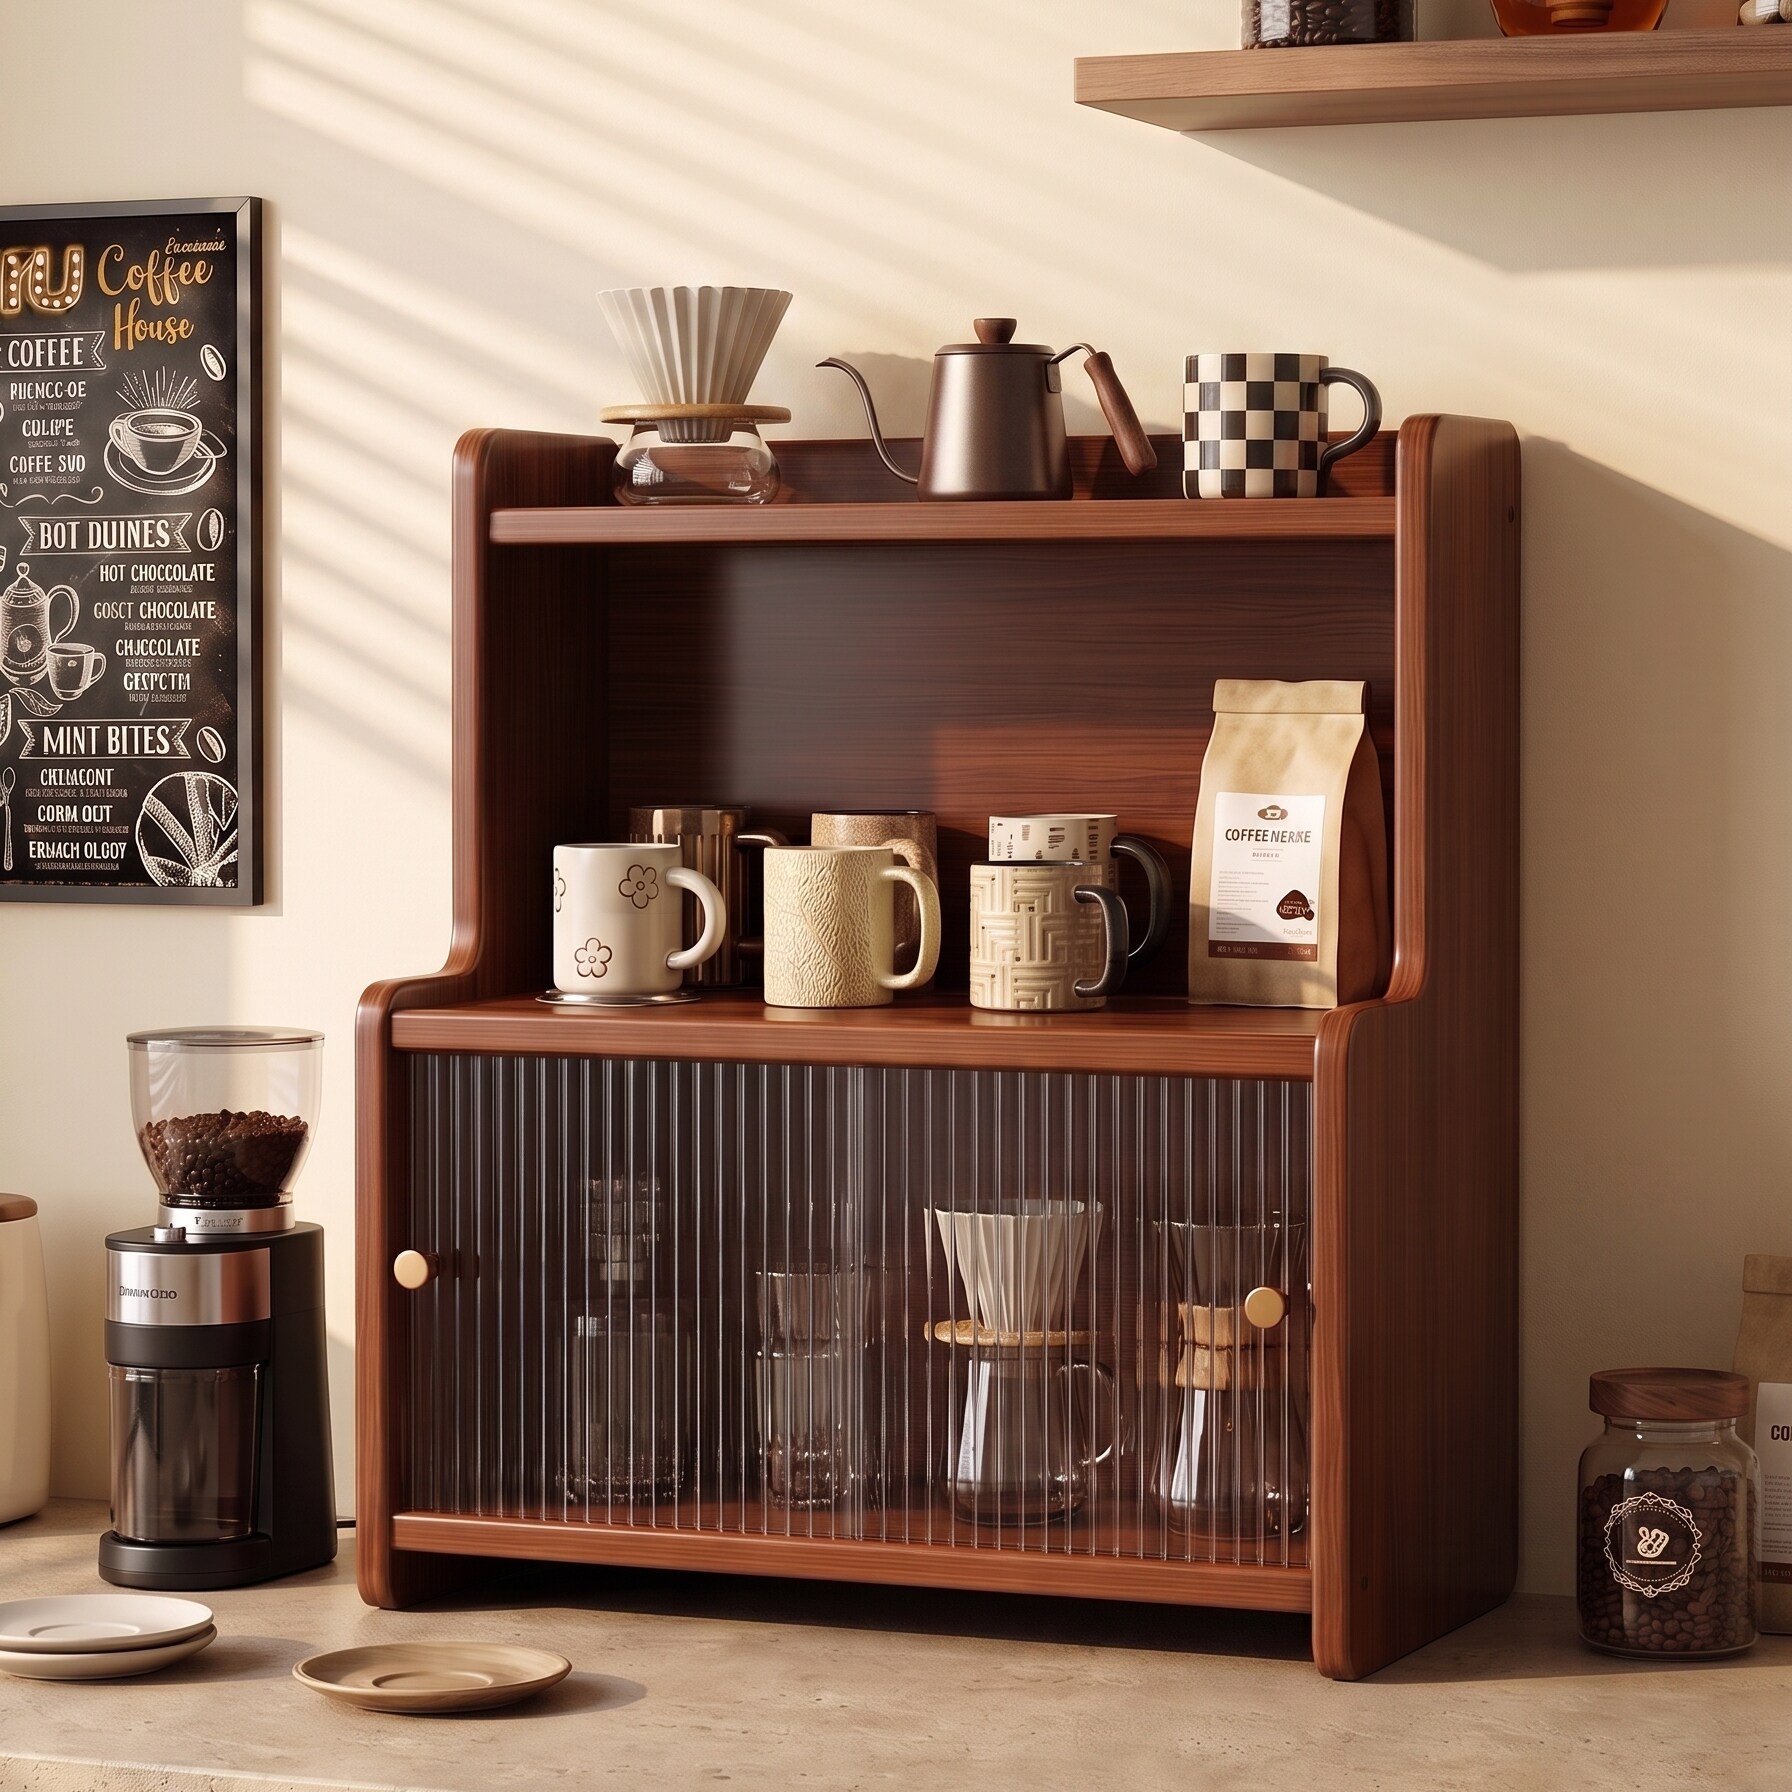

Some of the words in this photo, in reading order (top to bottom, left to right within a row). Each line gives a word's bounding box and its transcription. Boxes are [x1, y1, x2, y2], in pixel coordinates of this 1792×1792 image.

[98, 244, 213, 306] Coffee
[114, 297, 194, 350] House
[8, 337, 84, 368] COFFEE
[39, 521, 80, 550] BOT
[87, 519, 171, 549] DUINES
[99, 564, 127, 582] HOT
[139, 601, 217, 619] CHOCOLATE
[43, 726, 100, 755] MINT
[107, 725, 170, 755] BITES
[1225, 828, 1269, 842] COFFEE
[1771, 1425, 1792, 1442] CO
